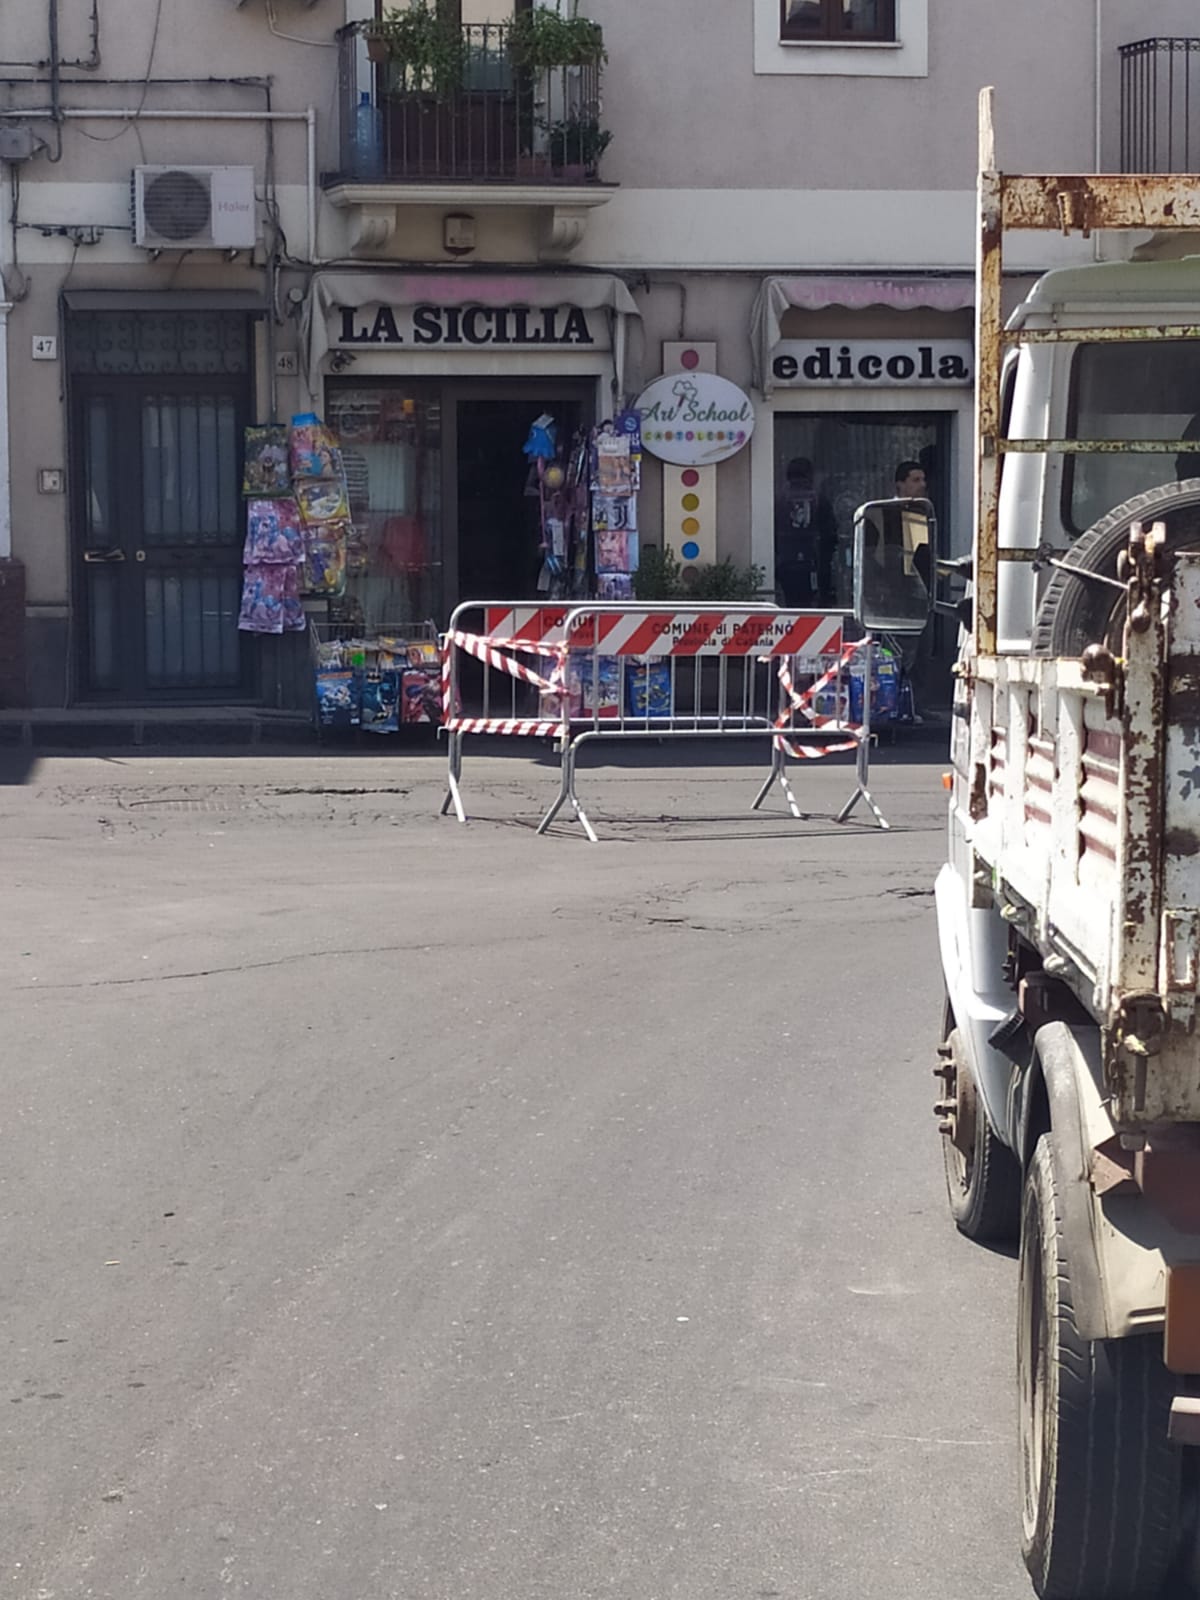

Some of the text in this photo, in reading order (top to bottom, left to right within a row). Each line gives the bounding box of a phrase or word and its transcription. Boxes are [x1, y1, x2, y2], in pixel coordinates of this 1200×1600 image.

[338, 306, 594, 344] LA SICILIA
[36, 340, 52, 352] 47
[278, 357, 293, 369] 48
[772, 346, 969, 379] edicola
[641, 400, 750, 422] Art School
[652, 620, 794, 635] COMUNE di PATERNÒ
